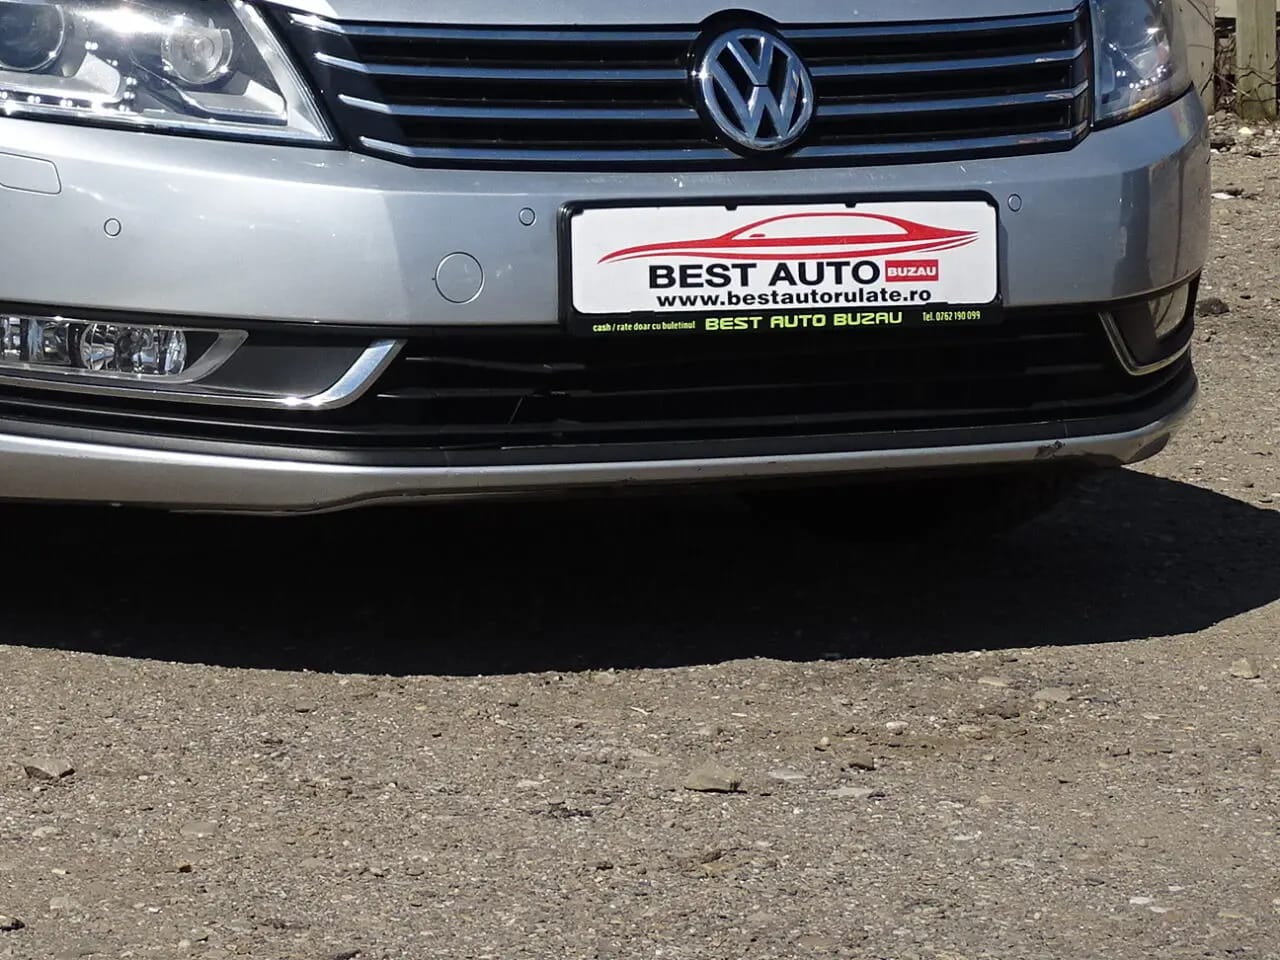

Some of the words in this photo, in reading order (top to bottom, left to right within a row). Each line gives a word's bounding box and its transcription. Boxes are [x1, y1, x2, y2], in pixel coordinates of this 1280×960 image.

[649, 263, 757, 289] BEST
[768, 260, 881, 288] AUTO
[887, 266, 937, 277] BUZAU
[657, 288, 932, 308] www.bestautorulate.ro
[592, 323, 612, 332] cash
[617, 323, 632, 331] rate
[633, 322, 651, 331] doar
[662, 320, 696, 330] buletinul
[705, 316, 763, 331] BEST
[770, 312, 826, 329] AUTO
[833, 311, 903, 327] BUZAU
[922, 311, 935, 322] Tel.
[936, 311, 953, 321] 0762
[954, 311, 966, 320] 190
[967, 310, 981, 320] 099
